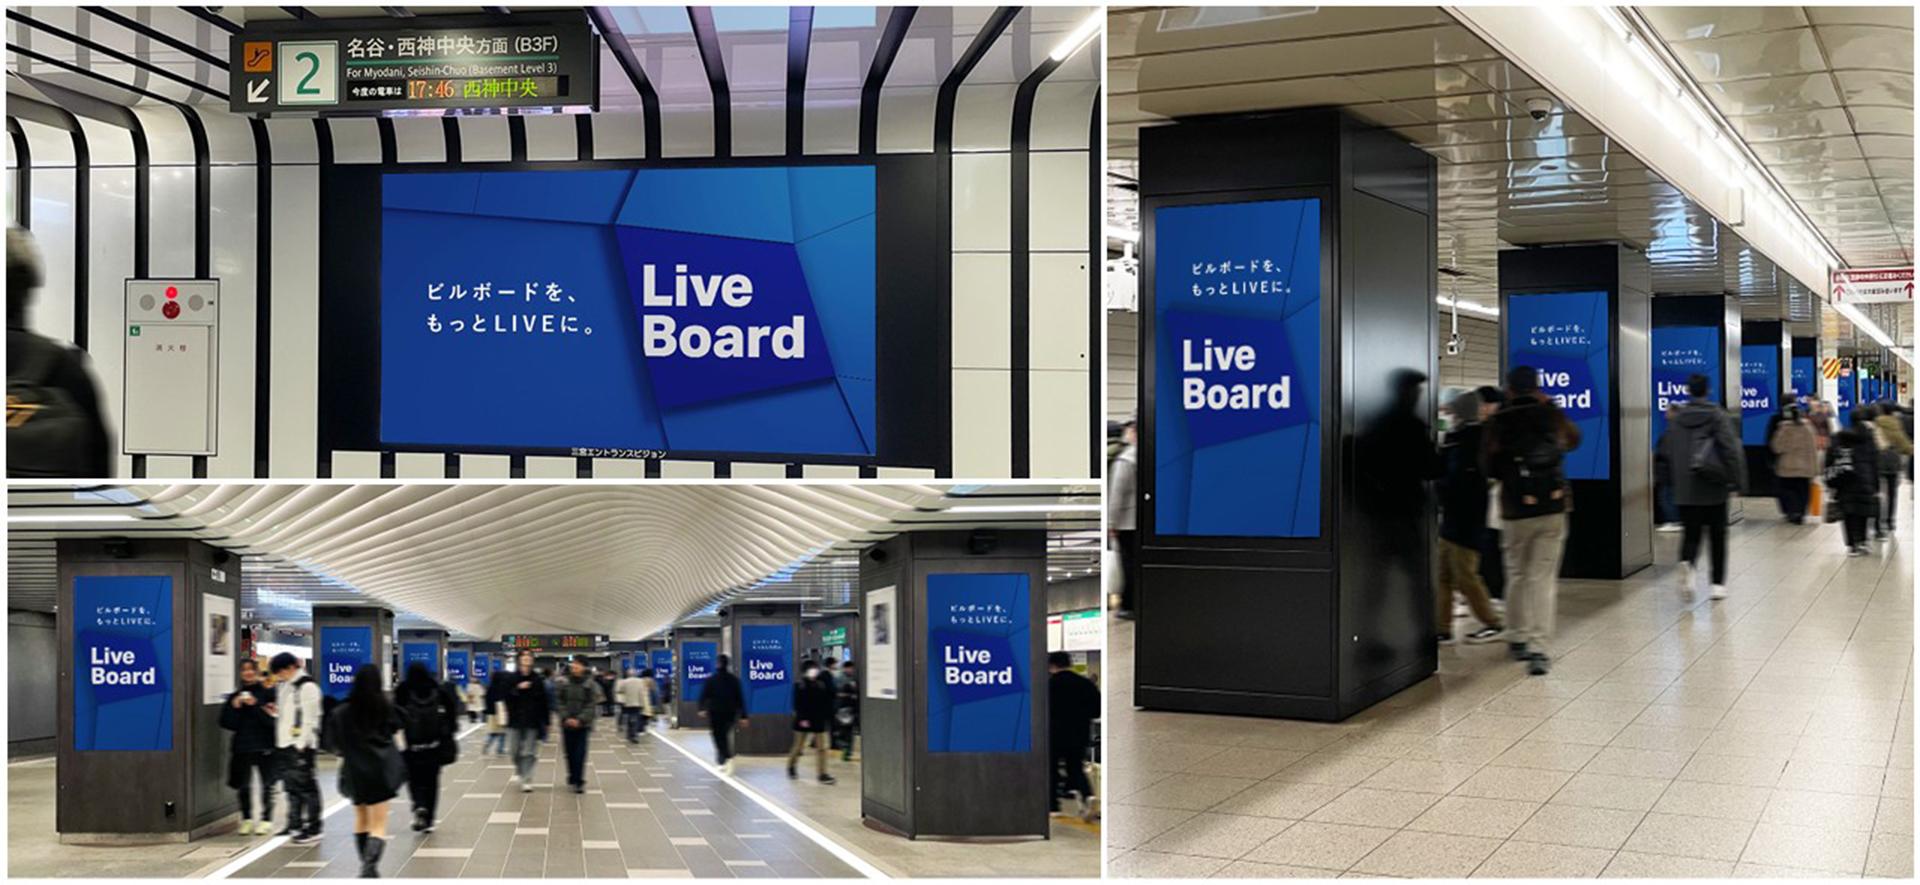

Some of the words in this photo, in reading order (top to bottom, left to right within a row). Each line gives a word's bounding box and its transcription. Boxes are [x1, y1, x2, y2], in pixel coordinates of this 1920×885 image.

[347, 35, 508, 58] 名谷・西神中央方面
[515, 35, 558, 53] (B3F)
[295, 51, 321, 95] 2
[346, 67, 361, 78] For
[363, 66, 406, 80] Myodani,
[408, 64, 467, 77] Seishin-Chuo
[468, 63, 519, 76] (Basement
[520, 62, 545, 74] Level
[547, 62, 558, 74] 3)
[352, 86, 402, 97] 今度の電車は
[408, 80, 454, 99] 17:46
[463, 78, 539, 99] 西神中央
[1192, 259, 1282, 275] ビルボードを、
[427, 282, 578, 303] ビルボードを、
[642, 264, 754, 308] Live
[1192, 280, 1292, 297] もっとLIVEに。
[427, 314, 593, 335] もっとLIVEに。
[642, 315, 806, 360] Board
[1182, 339, 1257, 372] Live
[1537, 368, 1571, 388] ive
[1182, 375, 1291, 410] Board
[1554, 389, 1592, 408] ard
[1740, 397, 1769, 408] oard
[91, 647, 135, 665] Live
[945, 646, 991, 664] Live
[329, 662, 353, 673] Live
[750, 660, 774, 670] Live
[91, 667, 155, 685] Board
[329, 673, 354, 684] Boa
[750, 670, 784, 680] Board
[945, 666, 1012, 684] Board
